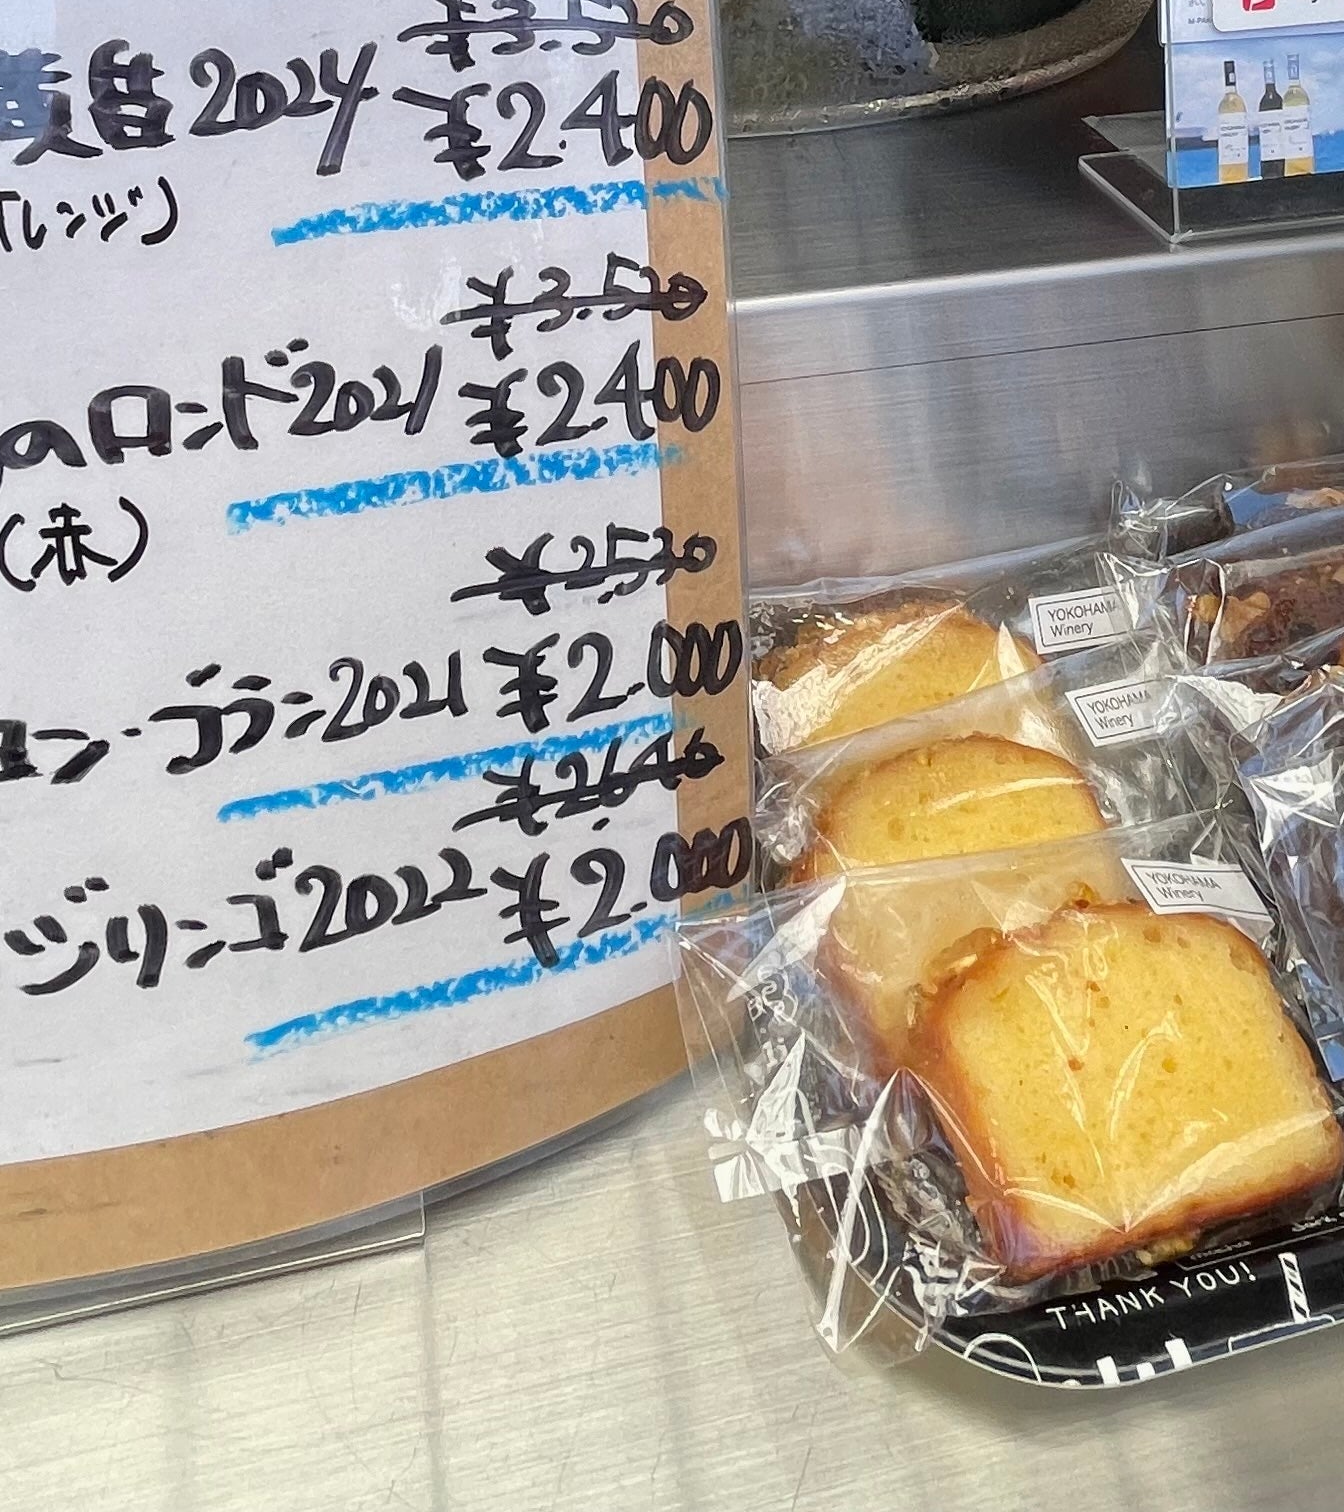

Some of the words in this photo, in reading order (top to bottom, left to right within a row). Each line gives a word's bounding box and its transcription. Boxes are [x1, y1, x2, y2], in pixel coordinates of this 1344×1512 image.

[392, 70, 713, 181] ¥2.400
[458, 340, 721, 457] ¥2.400
[1050, 621, 1094, 637] Winery
[483, 621, 743, 733] ¥2.000
[1087, 690, 1152, 714] YOKOHAMA
[1094, 713, 1135, 730] Winery
[490, 817, 752, 967] ¥2.000
[1145, 872, 1222, 890] YOKOHAMA
[1156, 886, 1205, 902] Winery
[1046, 1287, 1165, 1331] THANK
[1170, 1262, 1259, 1302] YOU!
